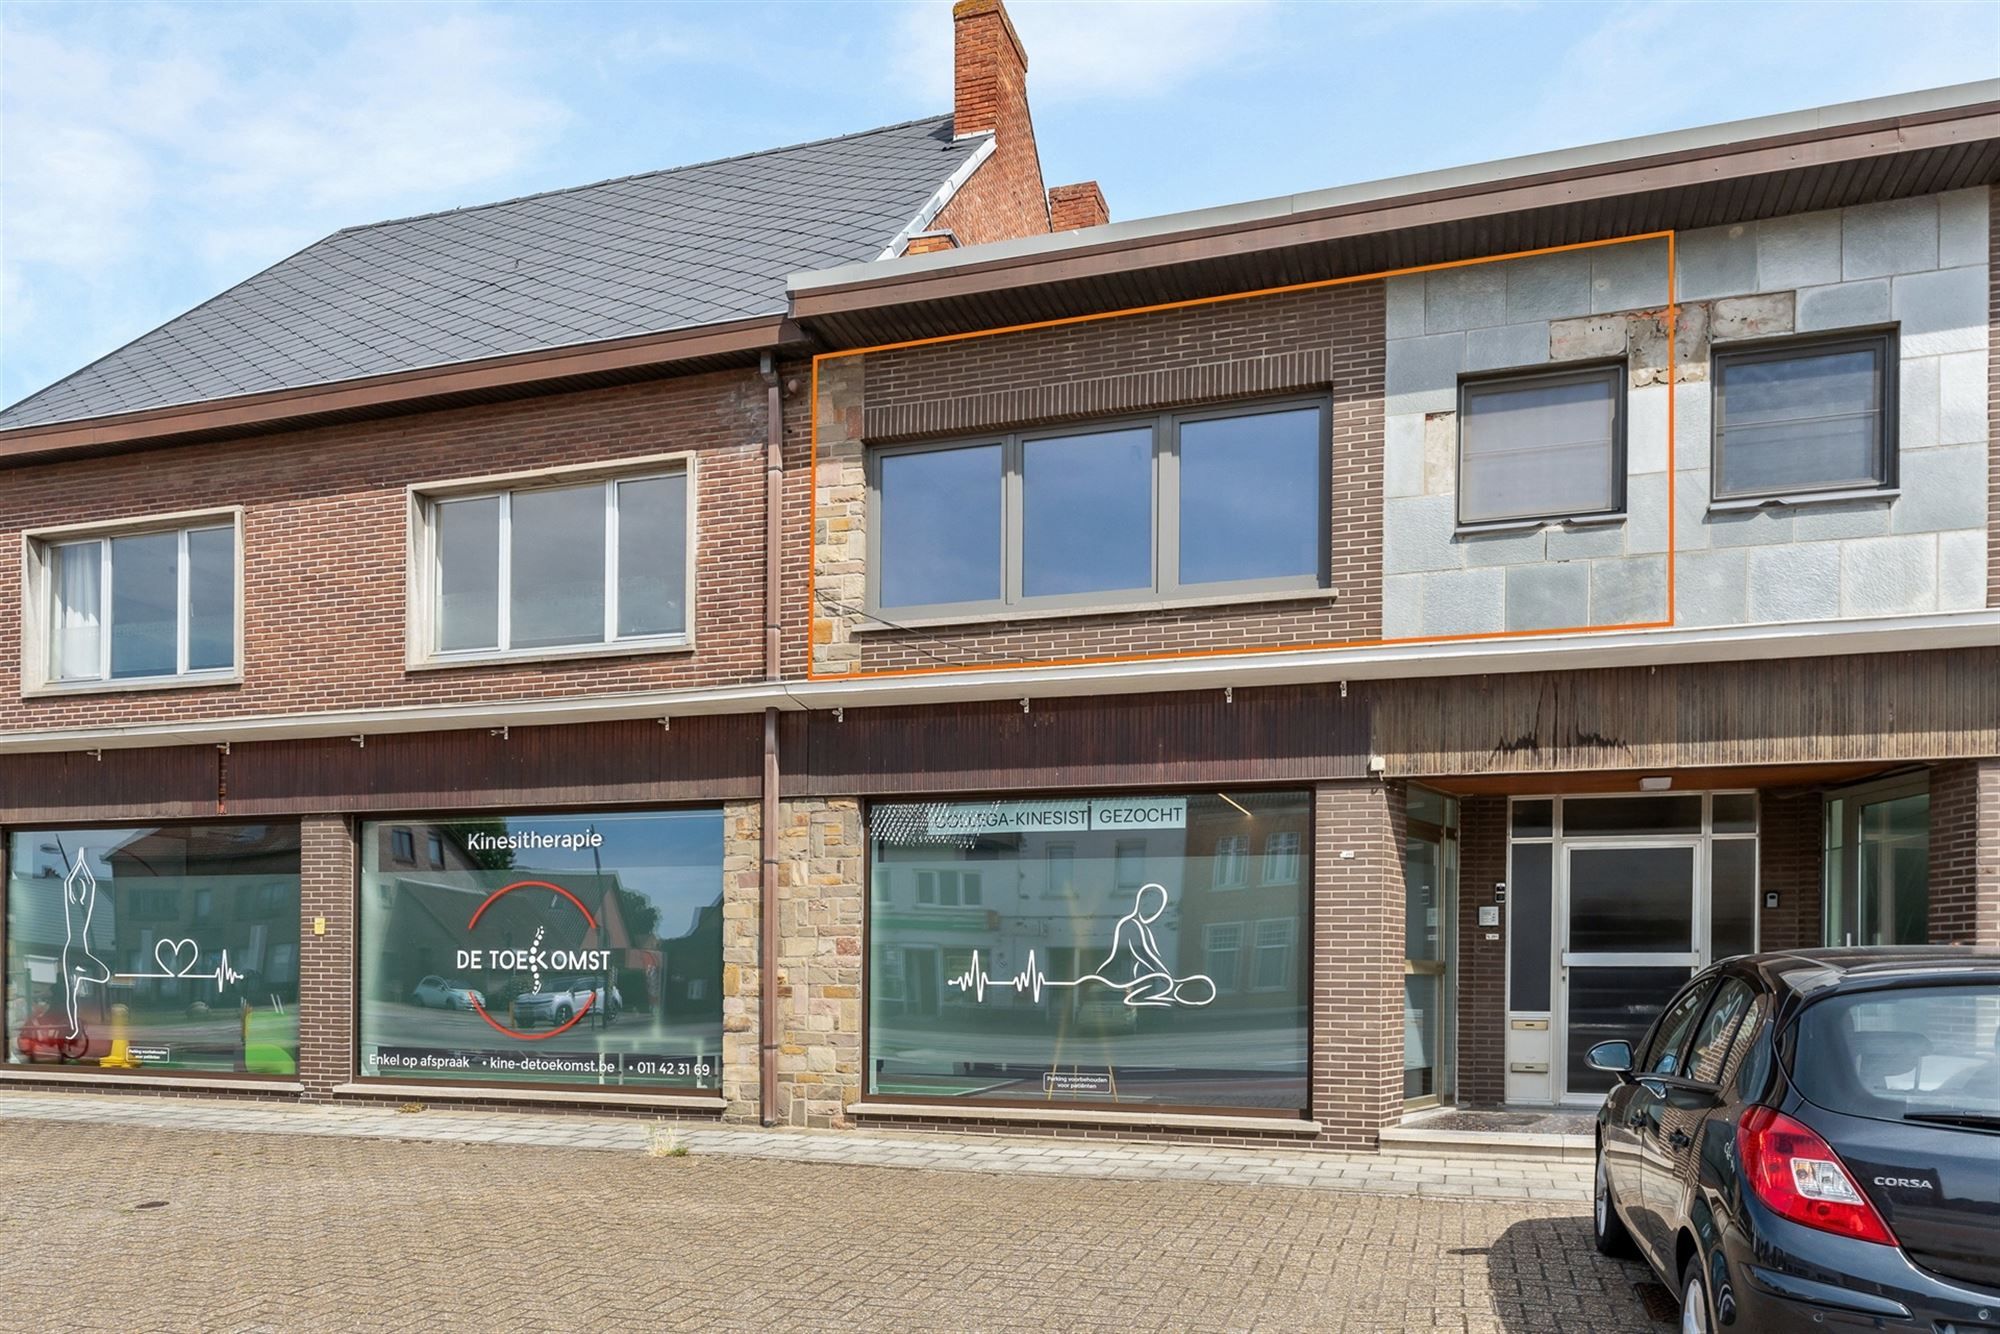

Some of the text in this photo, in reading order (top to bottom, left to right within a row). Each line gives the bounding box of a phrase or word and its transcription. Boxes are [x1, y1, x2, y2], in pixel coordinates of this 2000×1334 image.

[1099, 807, 1183, 825] GEZOCHT
[467, 828, 603, 851] Kinesitherapie
[456, 949, 611, 971] DE TOEKOMST
[369, 1053, 710, 1076] Enkel op afspraak kine-detoekomst.be 011 42 31 69
[1873, 1176, 1933, 1190] CORSA
